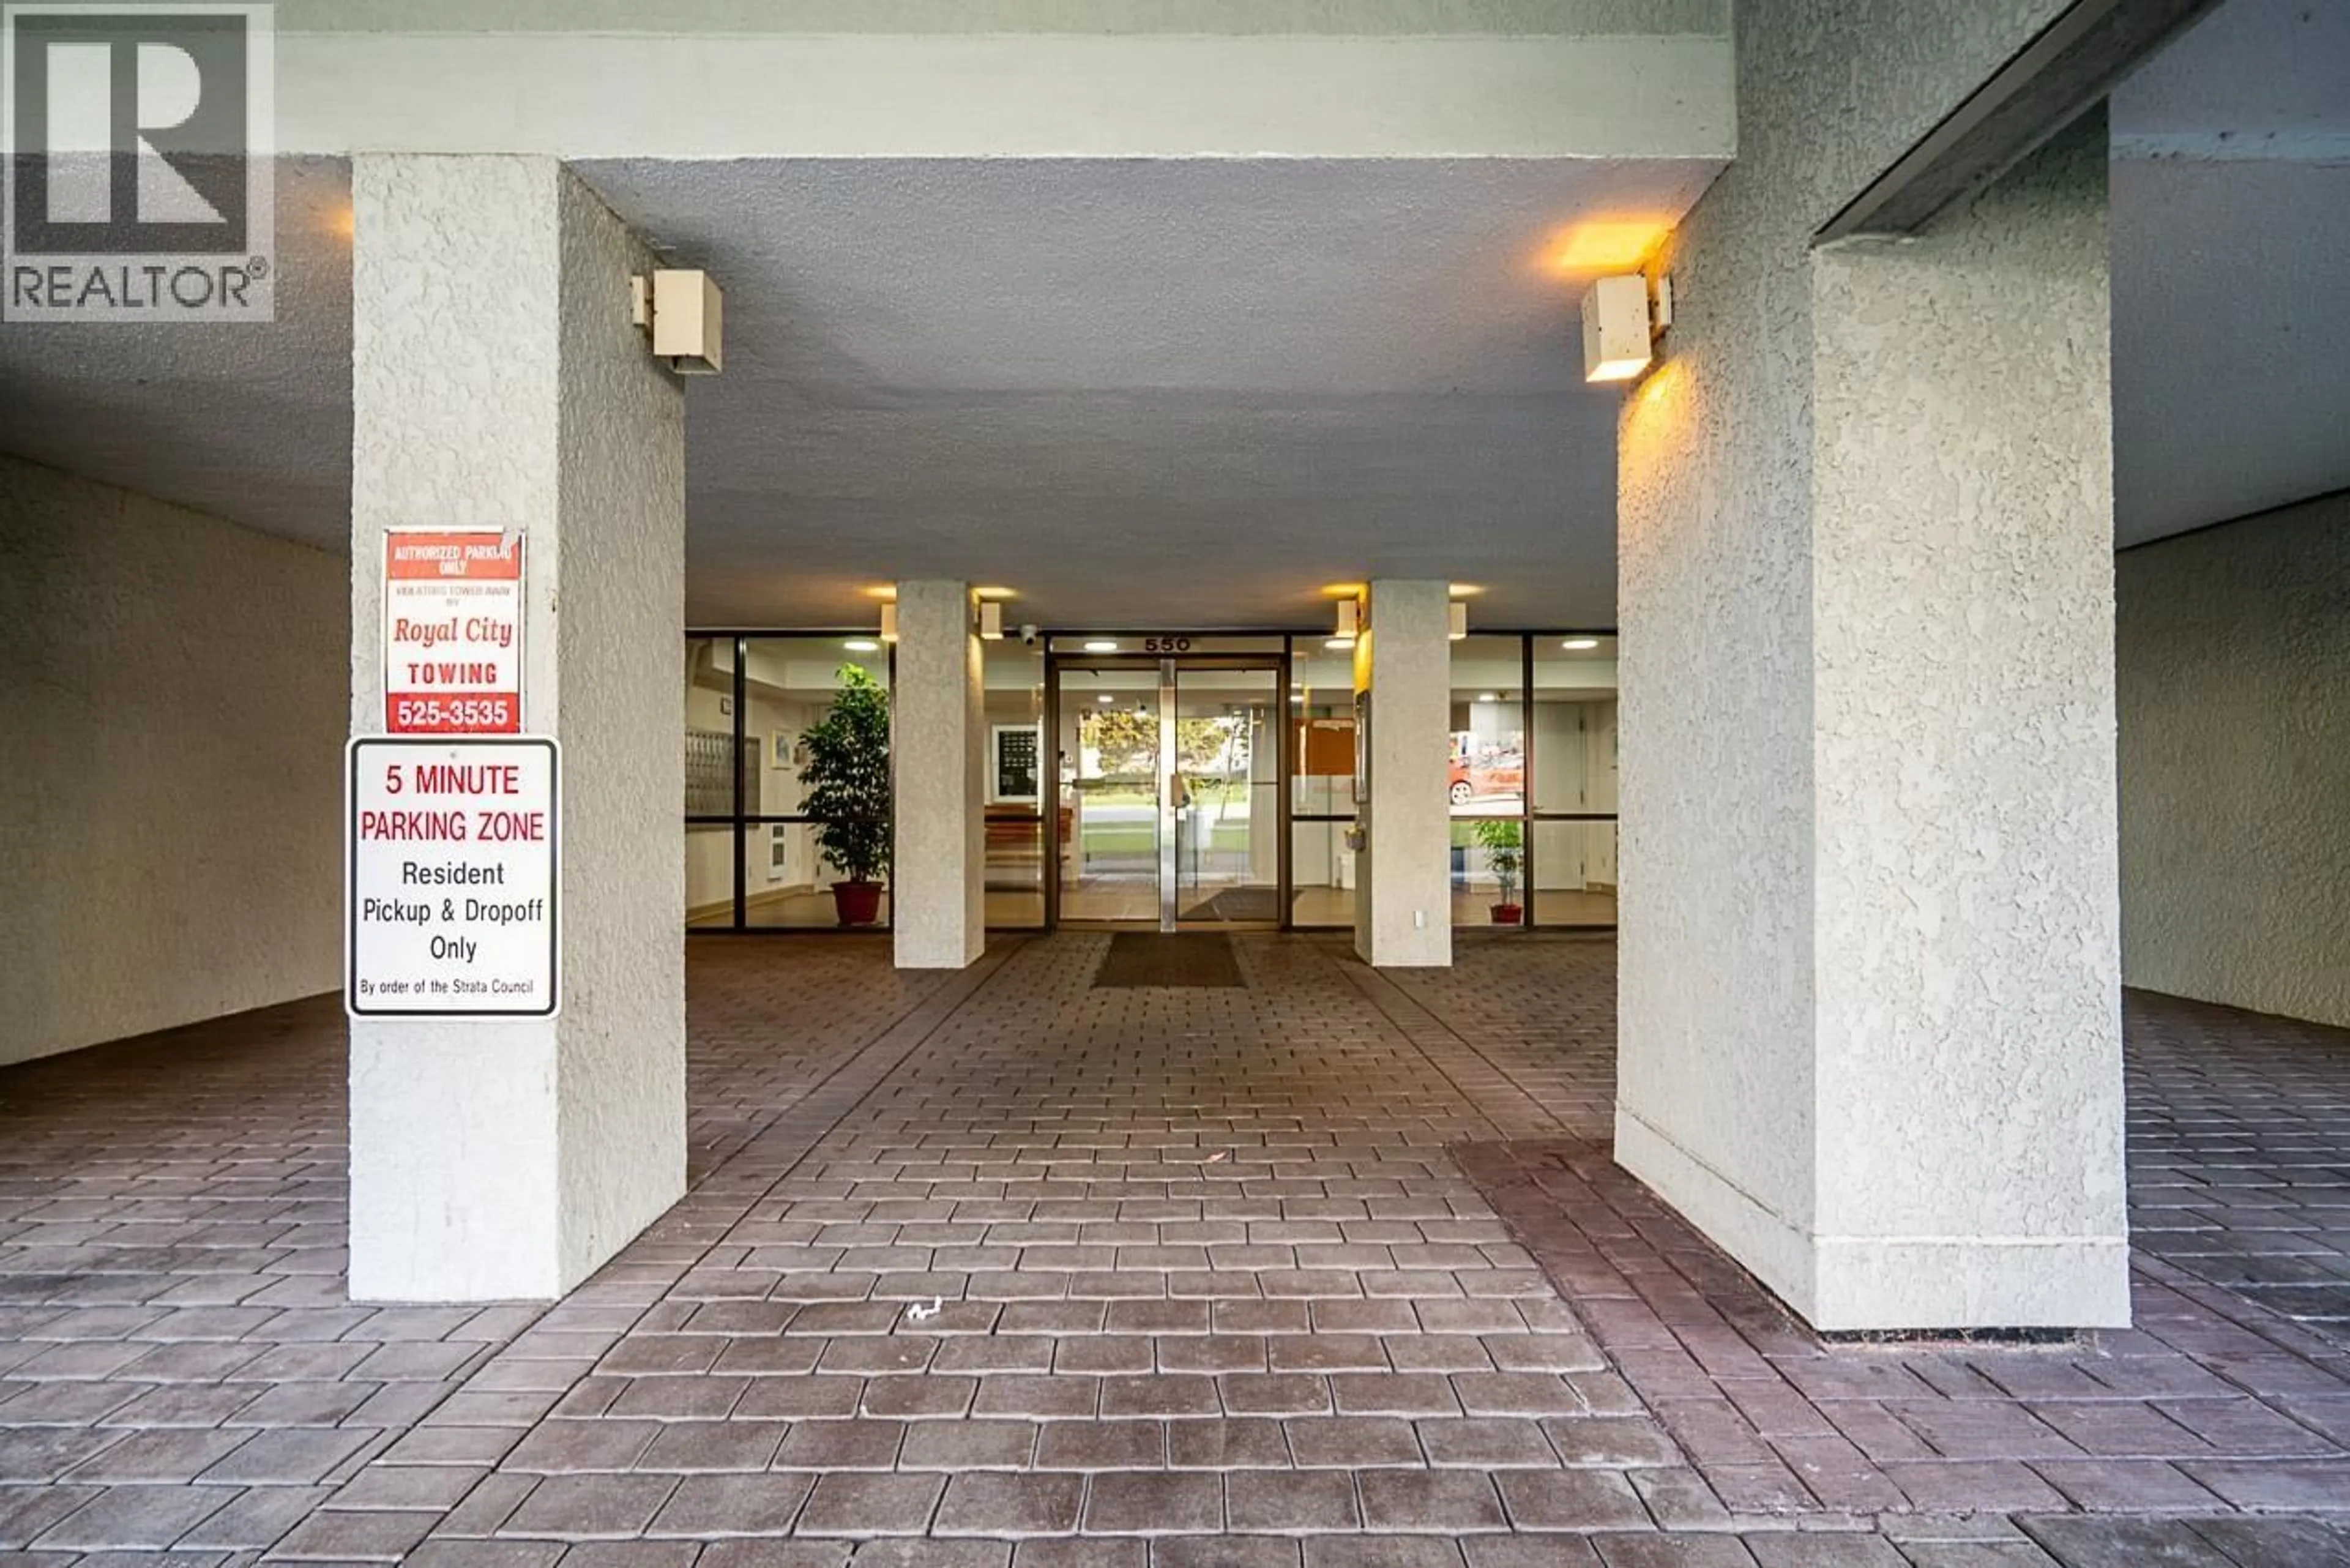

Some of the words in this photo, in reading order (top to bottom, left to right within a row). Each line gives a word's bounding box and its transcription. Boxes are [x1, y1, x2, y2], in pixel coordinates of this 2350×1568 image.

[395, 545, 461, 560] AUTHORIZED
[439, 561, 468, 575] ONLY
[394, 617, 458, 648] Royal
[466, 617, 512, 648] City
[1145, 638, 1191, 651] 550
[407, 663, 497, 684] TOWING
[398, 700, 509, 726] 525-3535
[386, 766, 402, 794] 5
[416, 765, 520, 794] MINUTE
[361, 812, 467, 841] PARKING
[477, 812, 545, 841] ZONE
[401, 861, 505, 885] Resident
[364, 898, 431, 925] Pickup
[441, 899, 455, 922] &
[465, 898, 544, 925] Dropoff
[430, 935, 477, 963] Only
[360, 979, 375, 996] By
[379, 979, 409, 994] order
[414, 979, 426, 994] of
[431, 979, 449, 994] the
[453, 979, 488, 994] Strata
[491, 979, 534, 994] Council
